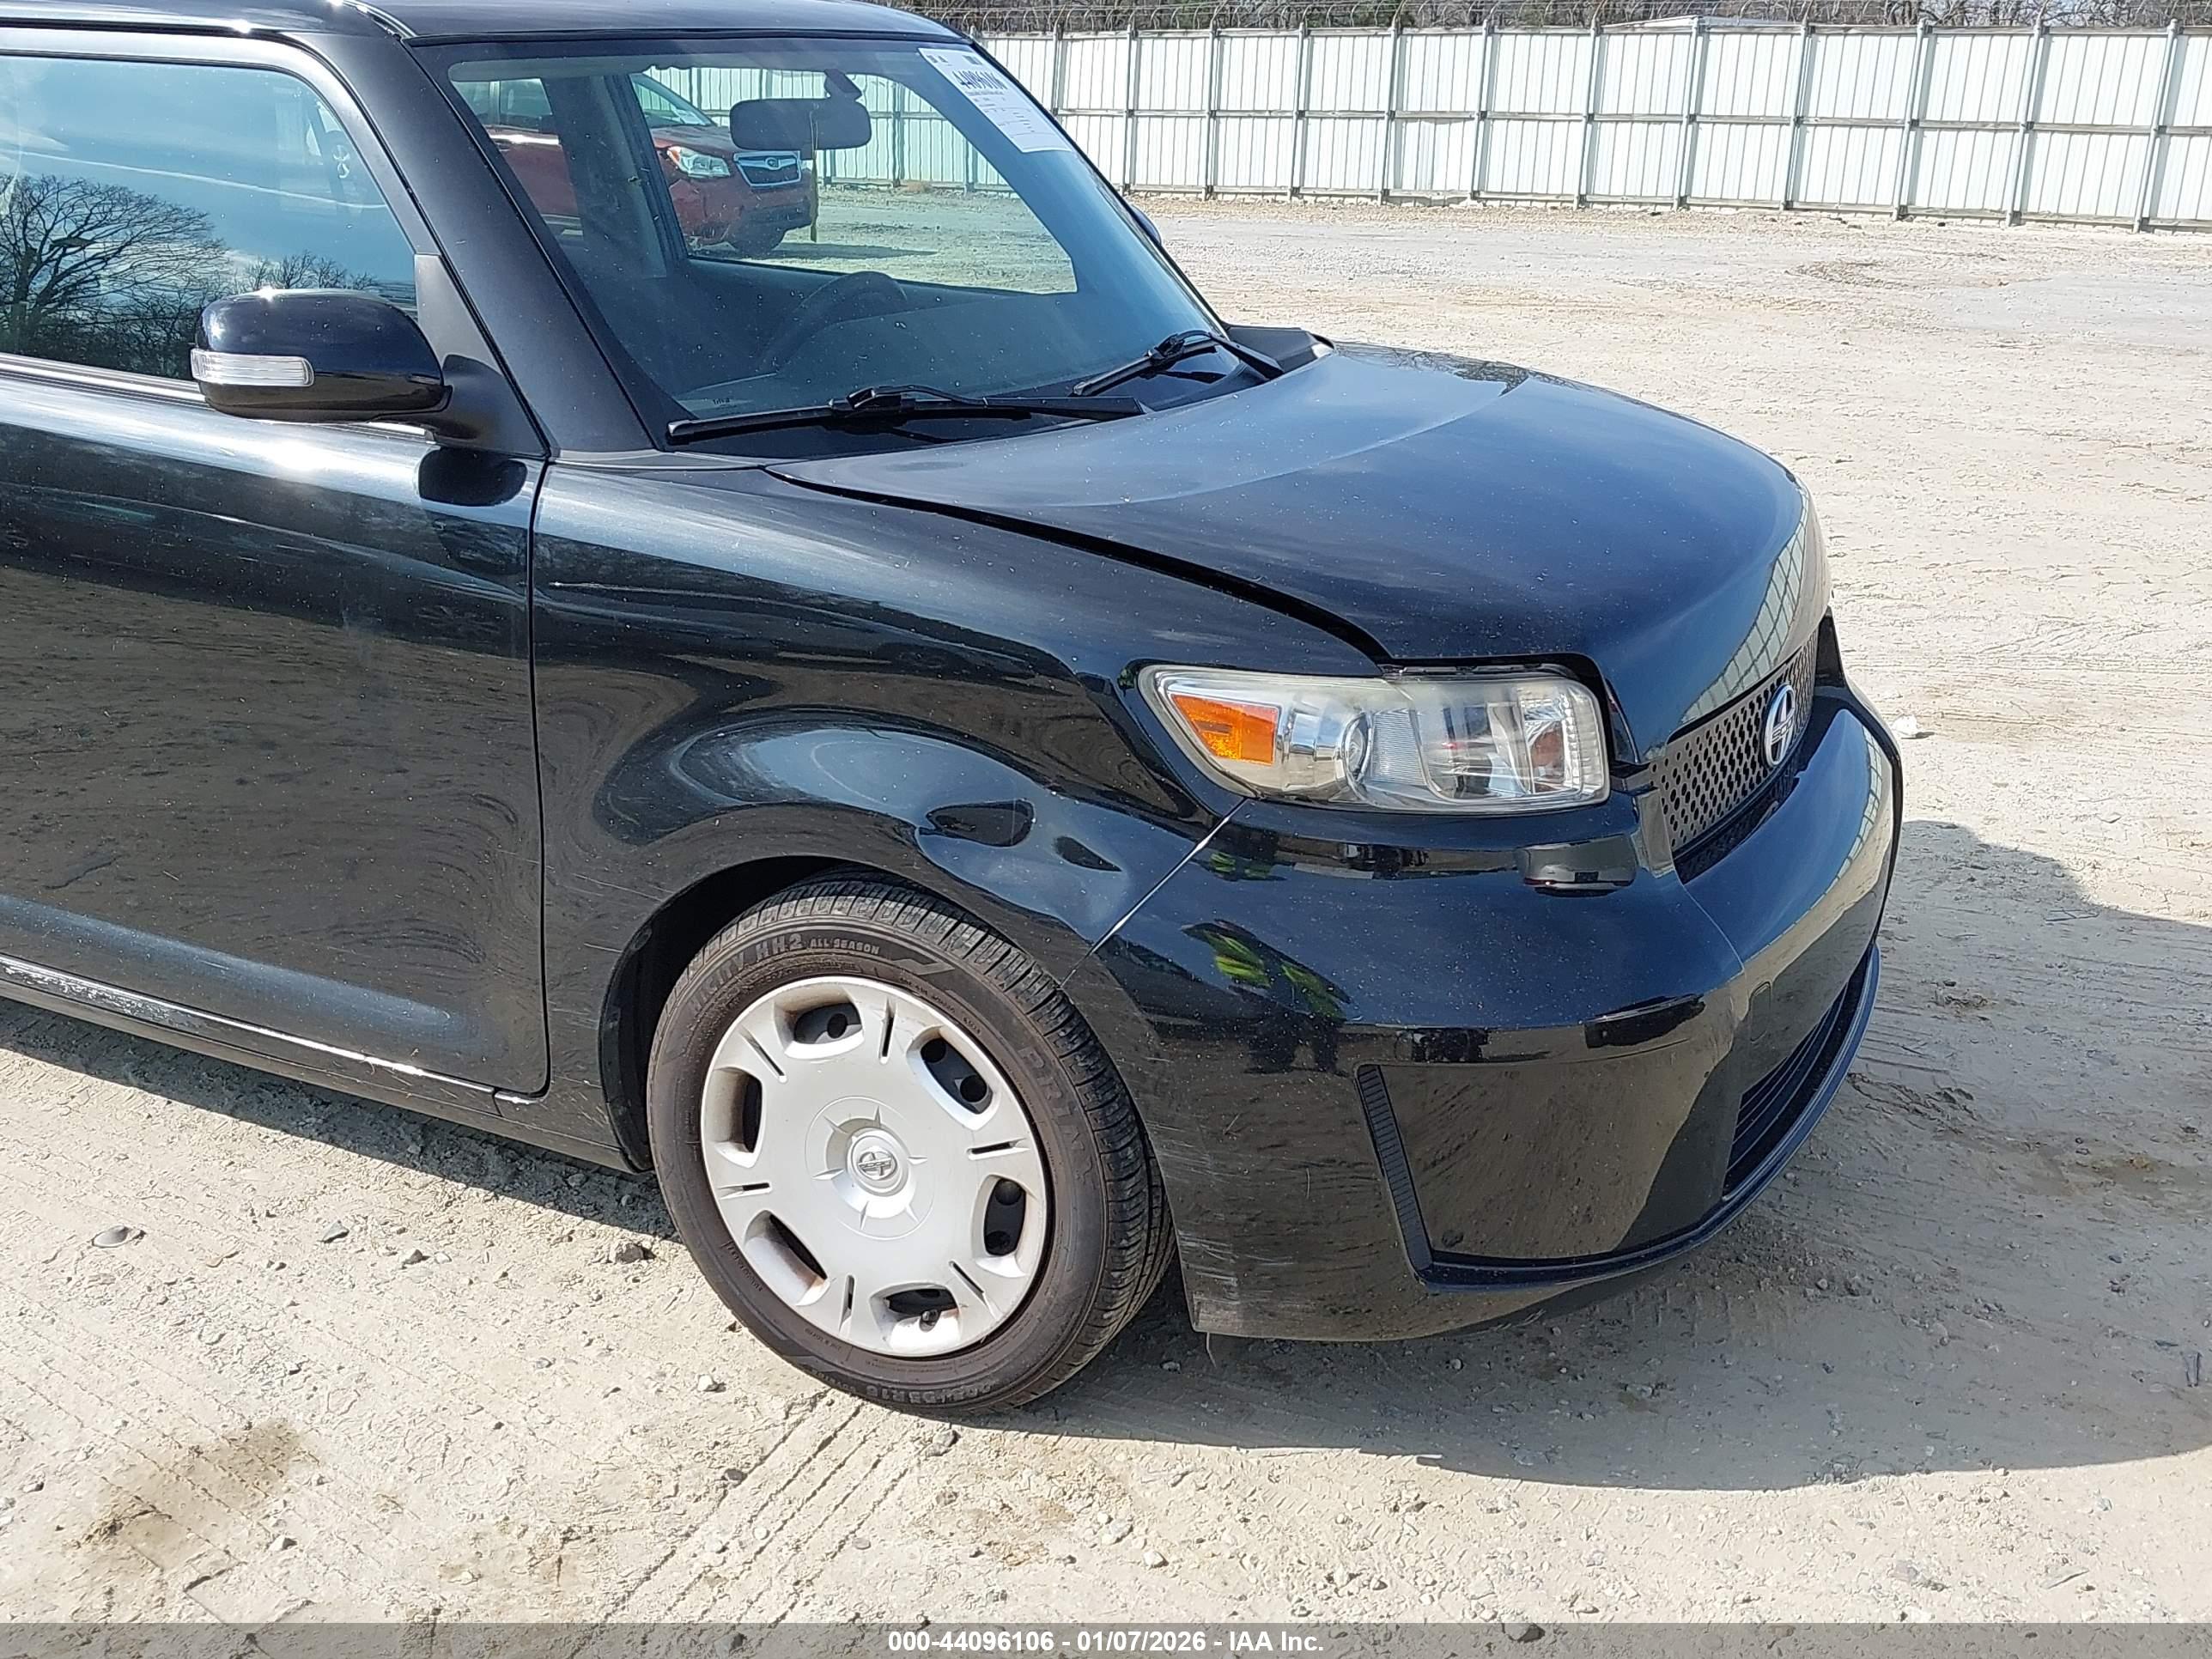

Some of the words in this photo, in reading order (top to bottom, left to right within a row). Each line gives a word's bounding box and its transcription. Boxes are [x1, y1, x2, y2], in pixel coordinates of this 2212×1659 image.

[755, 933, 804, 963] HH2
[809, 936, 830, 949] ALL
[831, 937, 880, 955] SEASON
